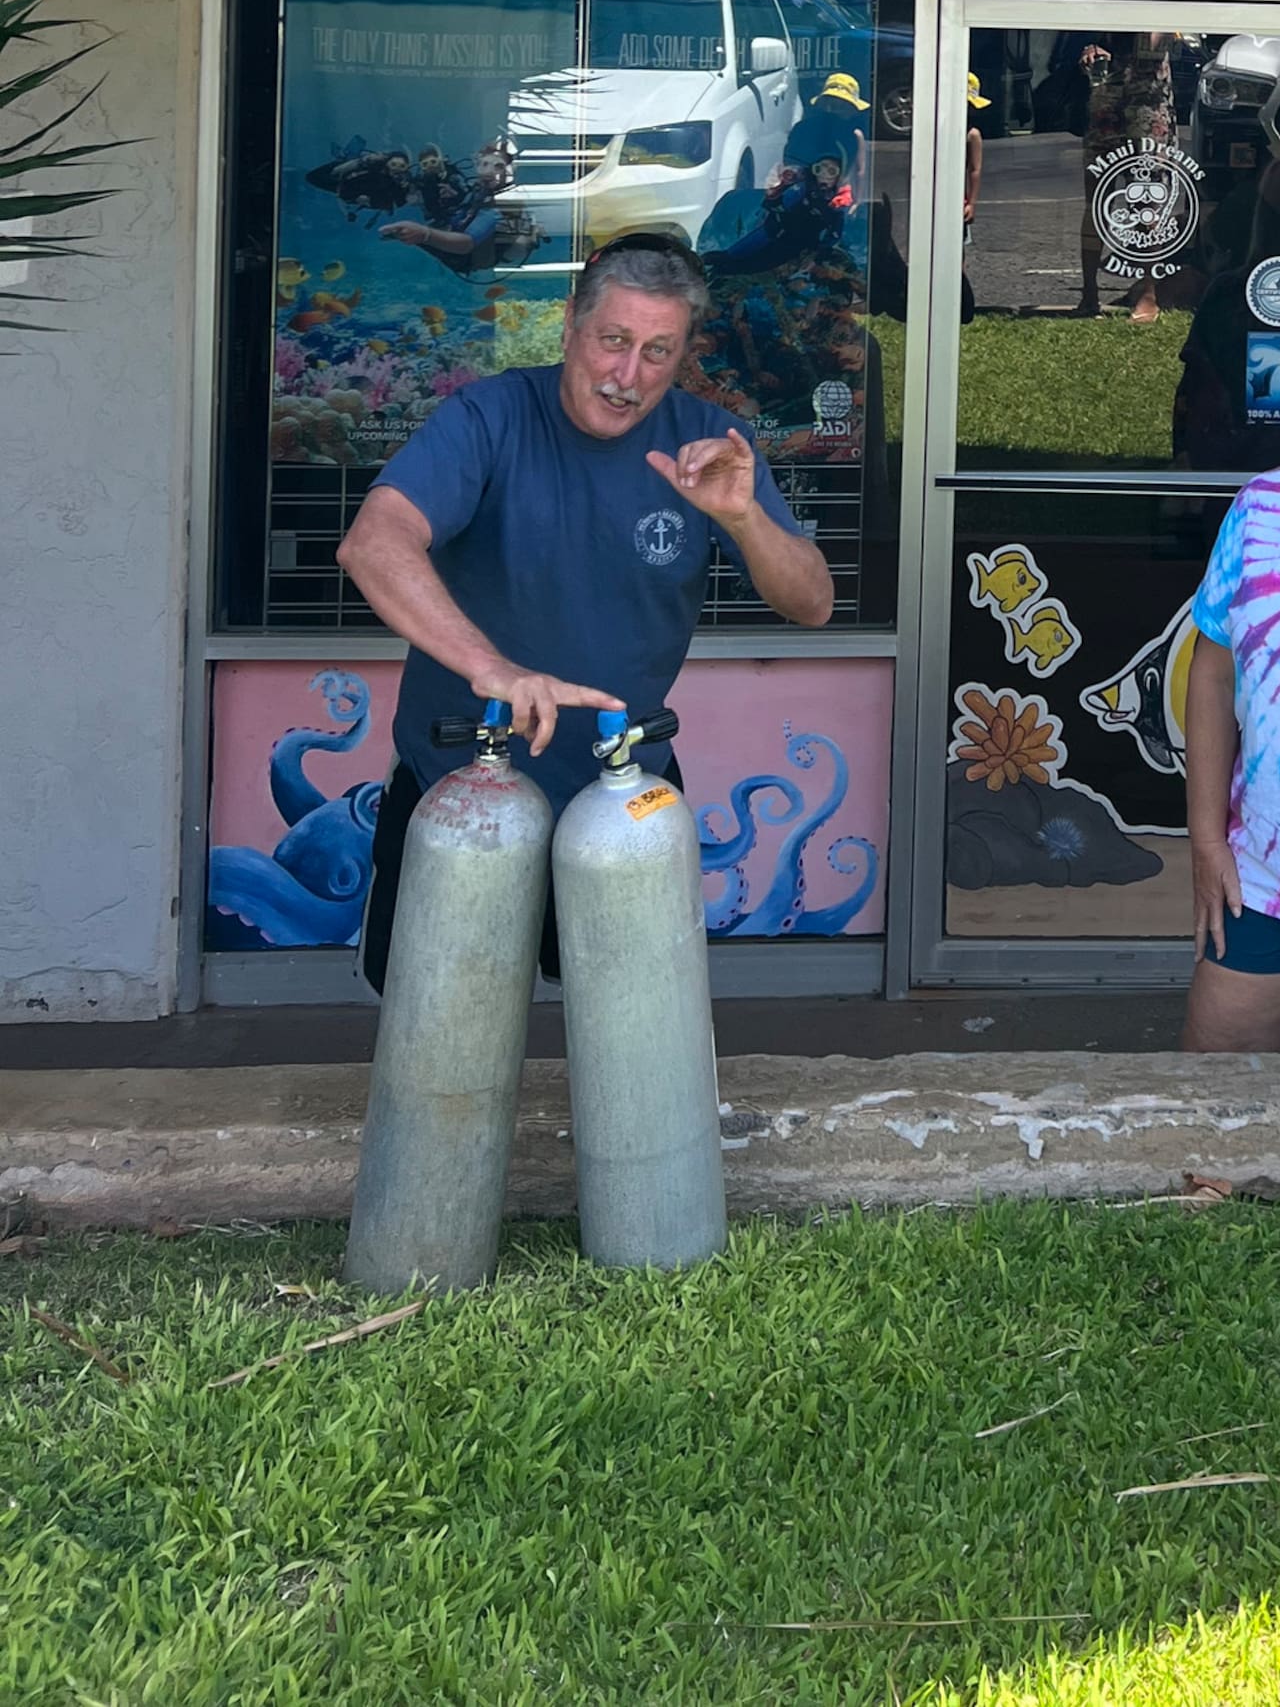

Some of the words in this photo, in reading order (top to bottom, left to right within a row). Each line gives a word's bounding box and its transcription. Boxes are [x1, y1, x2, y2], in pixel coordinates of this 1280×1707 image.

[311, 26, 338, 62] THE
[342, 29, 380, 64] ONLY
[383, 31, 428, 66] THING
[431, 33, 495, 68] MISSING
[499, 34, 515, 68] IS
[618, 33, 648, 67] ADD
[652, 35, 695, 69] SOME
[815, 36, 842, 69] LIFE
[1087, 139, 1135, 179] Maui
[1140, 137, 1206, 181] Dreams
[1104, 255, 1145, 279] Dive
[1151, 262, 1182, 279] Co.
[1247, 410, 1272, 418] 100%
[359, 420, 382, 430] ASK
[384, 420, 400, 430] US
[767, 419, 780, 429] OF
[812, 421, 852, 436] PADI
[347, 431, 408, 442] UPCOMING
